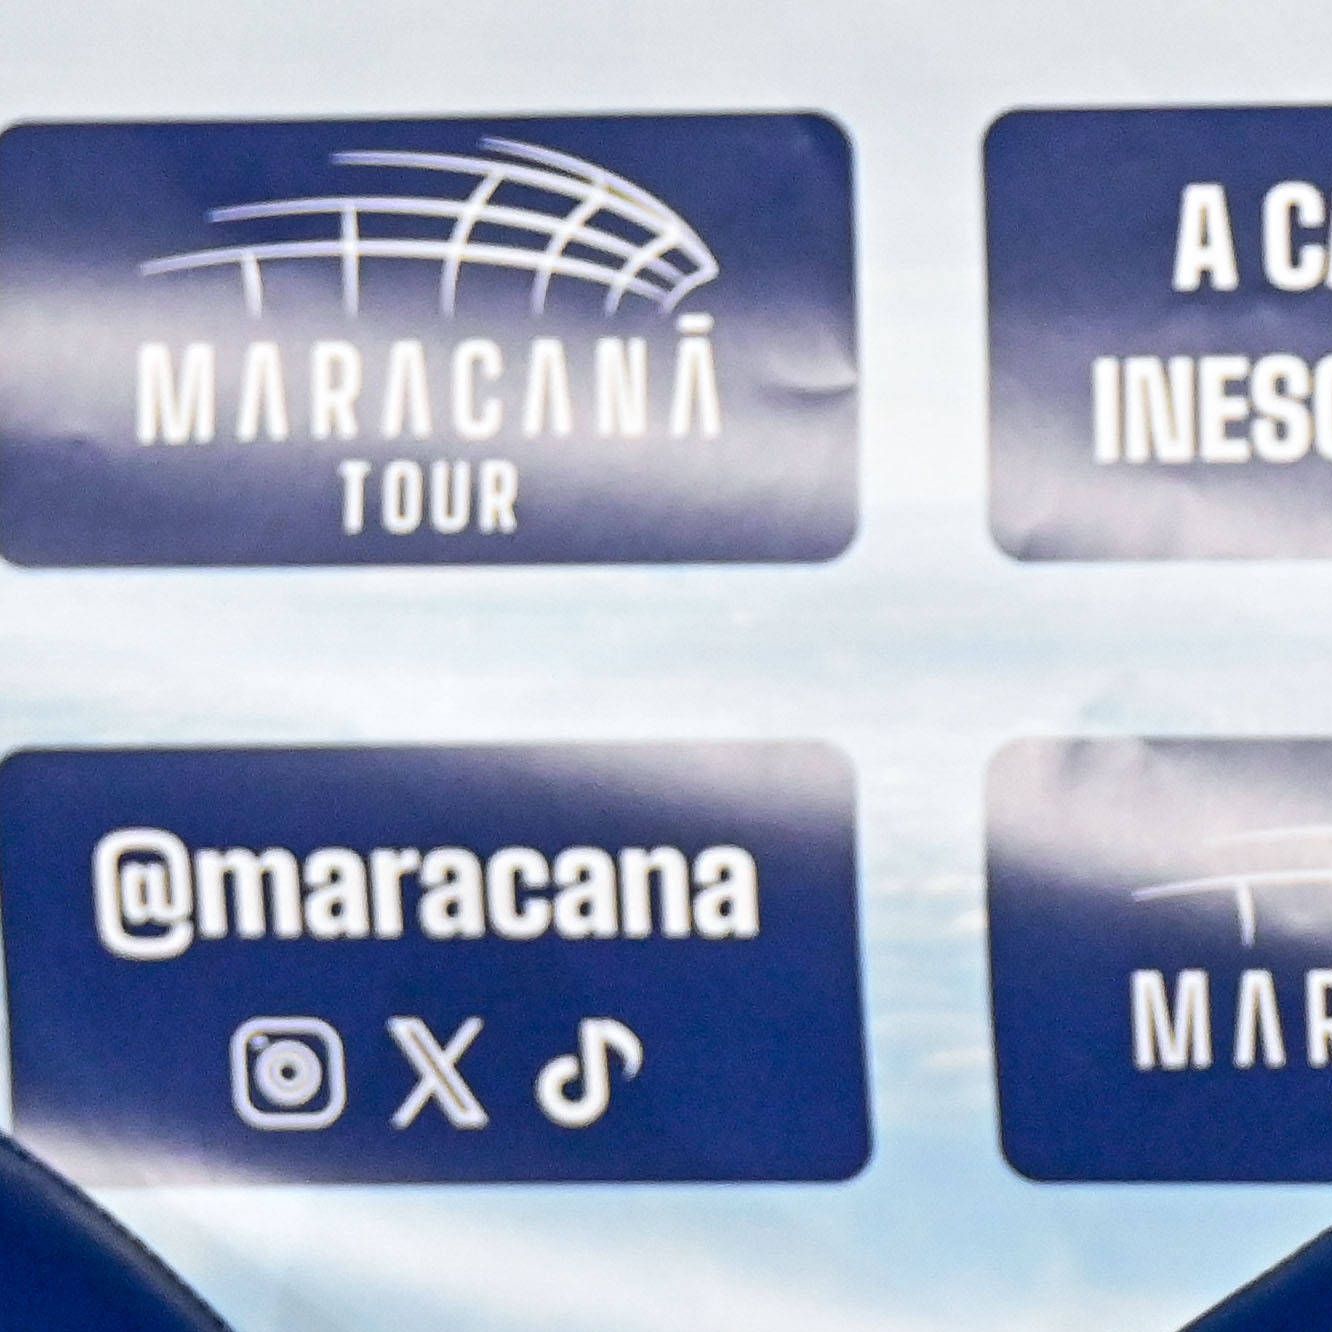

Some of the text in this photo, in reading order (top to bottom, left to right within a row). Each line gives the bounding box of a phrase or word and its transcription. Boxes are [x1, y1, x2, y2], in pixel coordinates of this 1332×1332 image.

[1173, 183, 1238, 291] A
[339, 459, 519, 534] TOUR
[94, 828, 759, 959] @maracana
